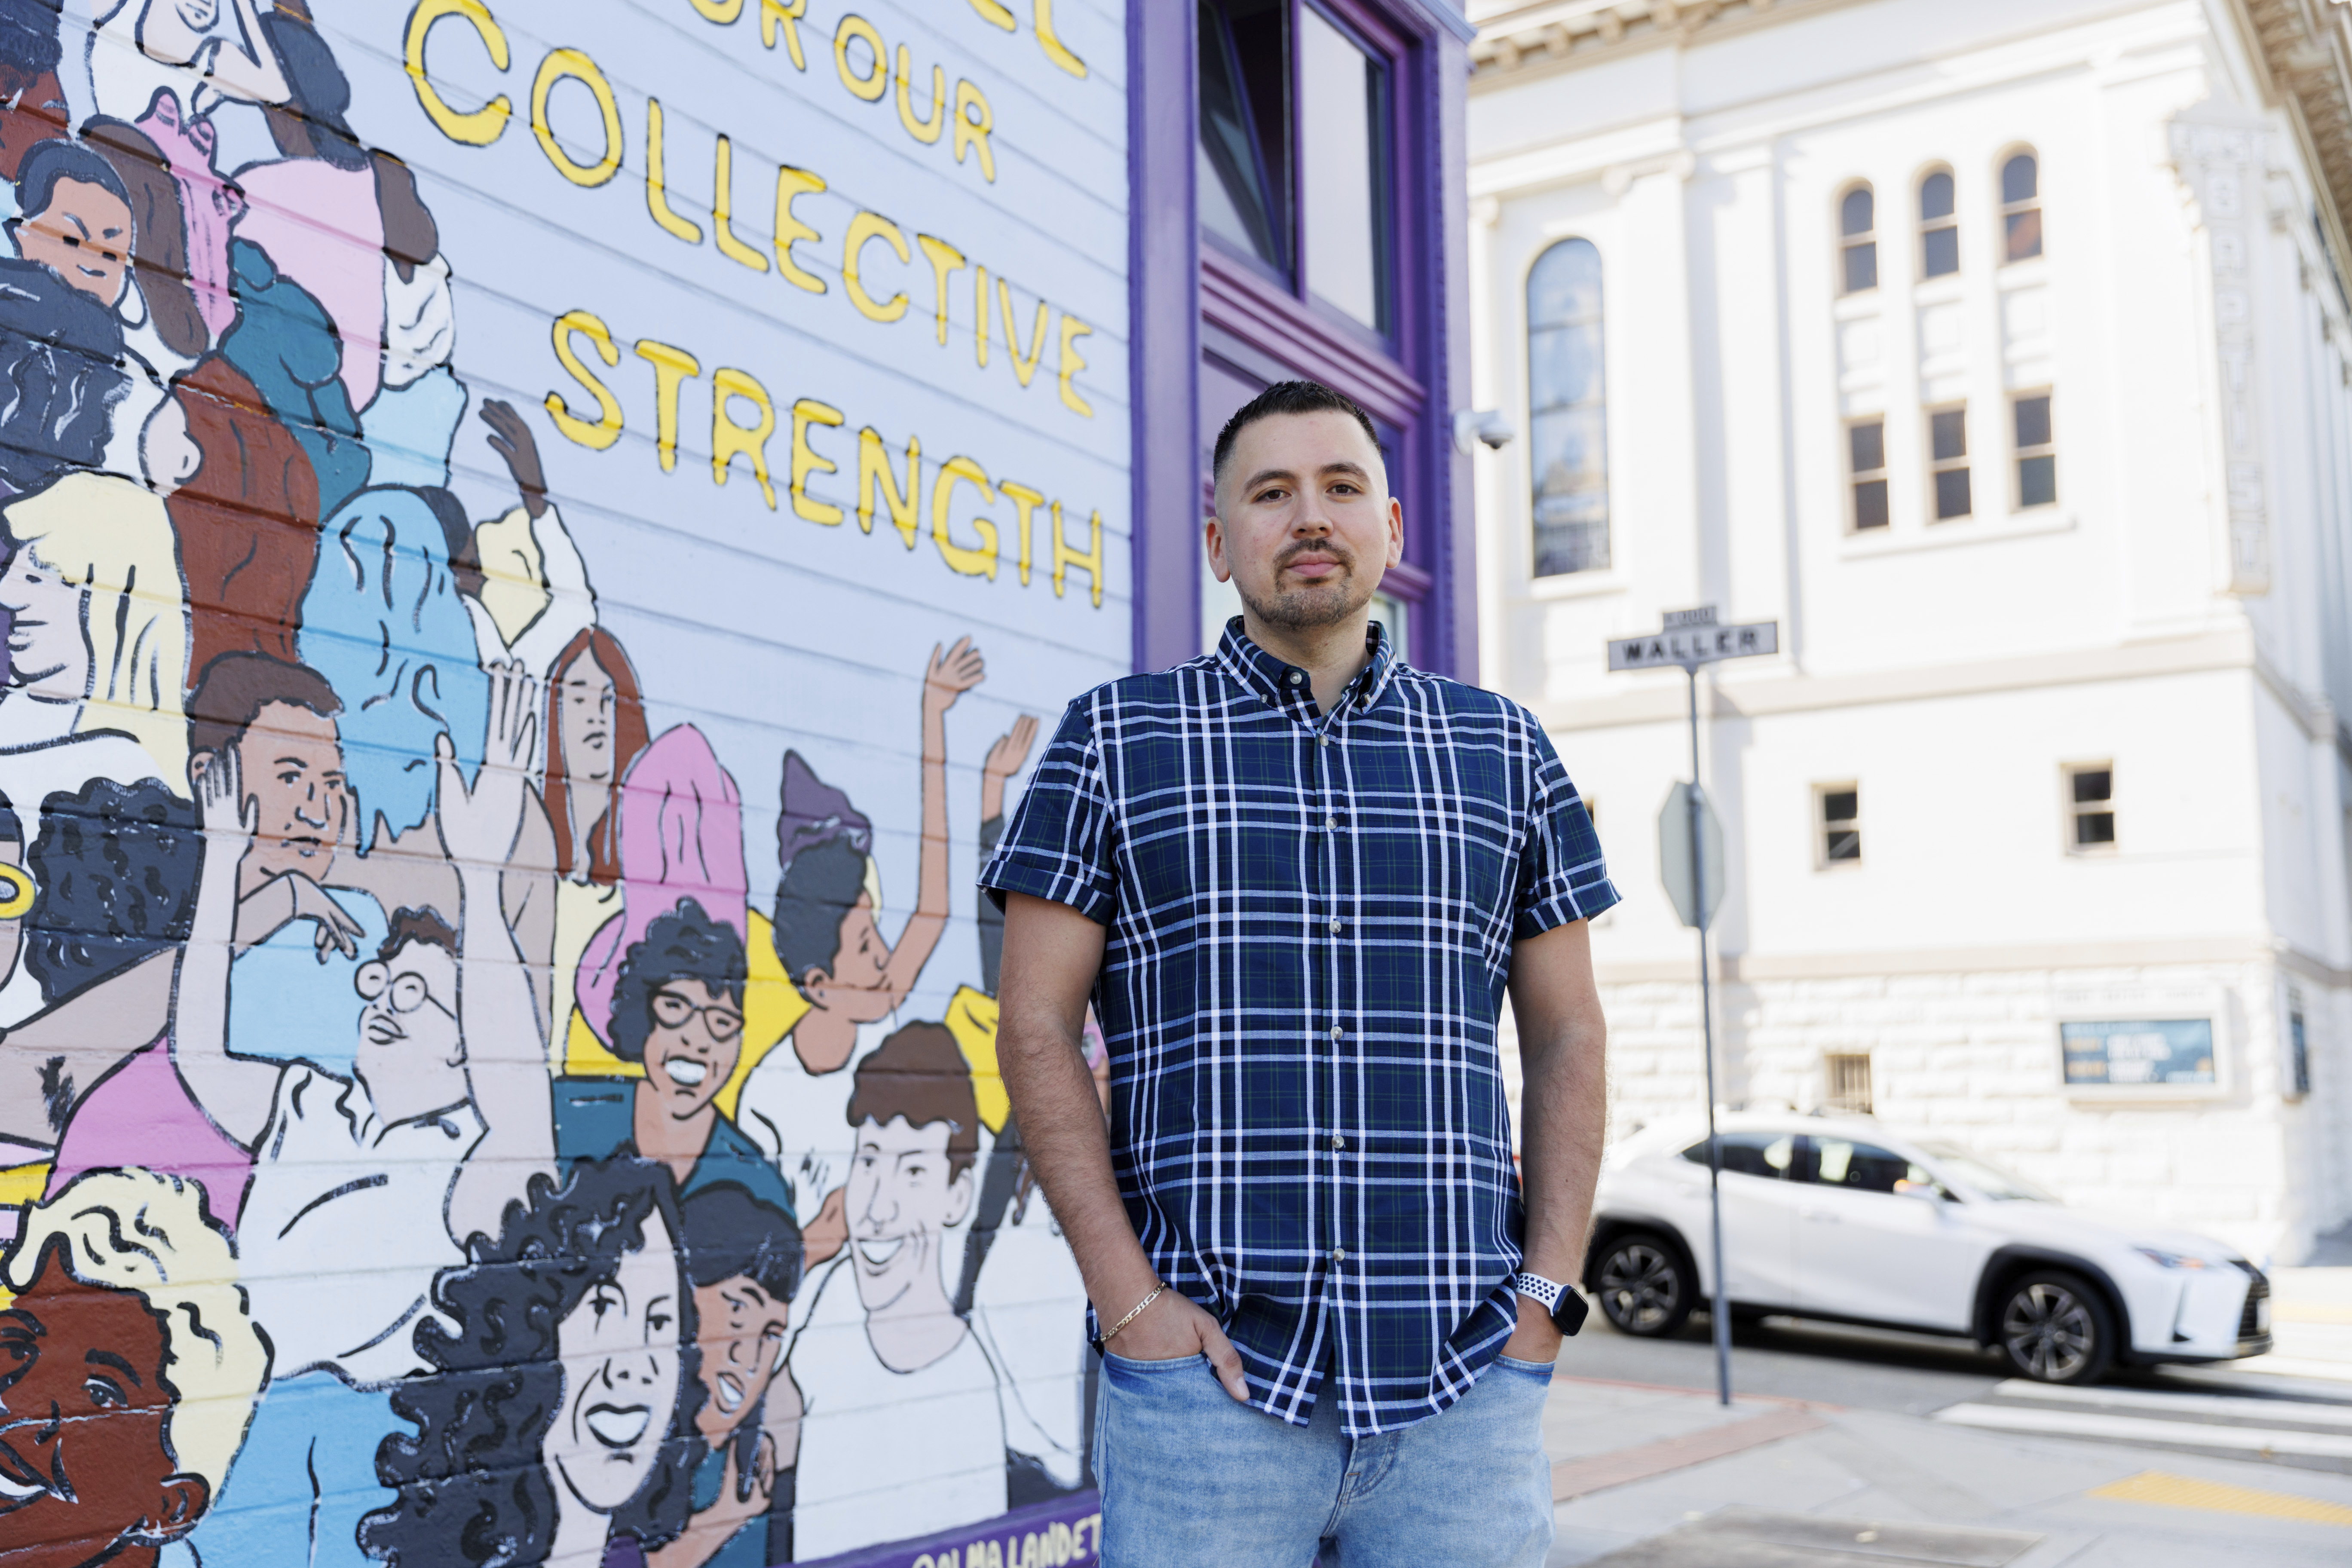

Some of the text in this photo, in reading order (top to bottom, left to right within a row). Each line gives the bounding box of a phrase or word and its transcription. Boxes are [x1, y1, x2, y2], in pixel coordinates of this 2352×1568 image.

[402, 0, 1094, 419] COLLECTIVE
[833, 14, 996, 184] OUR
[544, 309, 1104, 609] STRENGTH
[1624, 628, 1758, 662] WALLER
